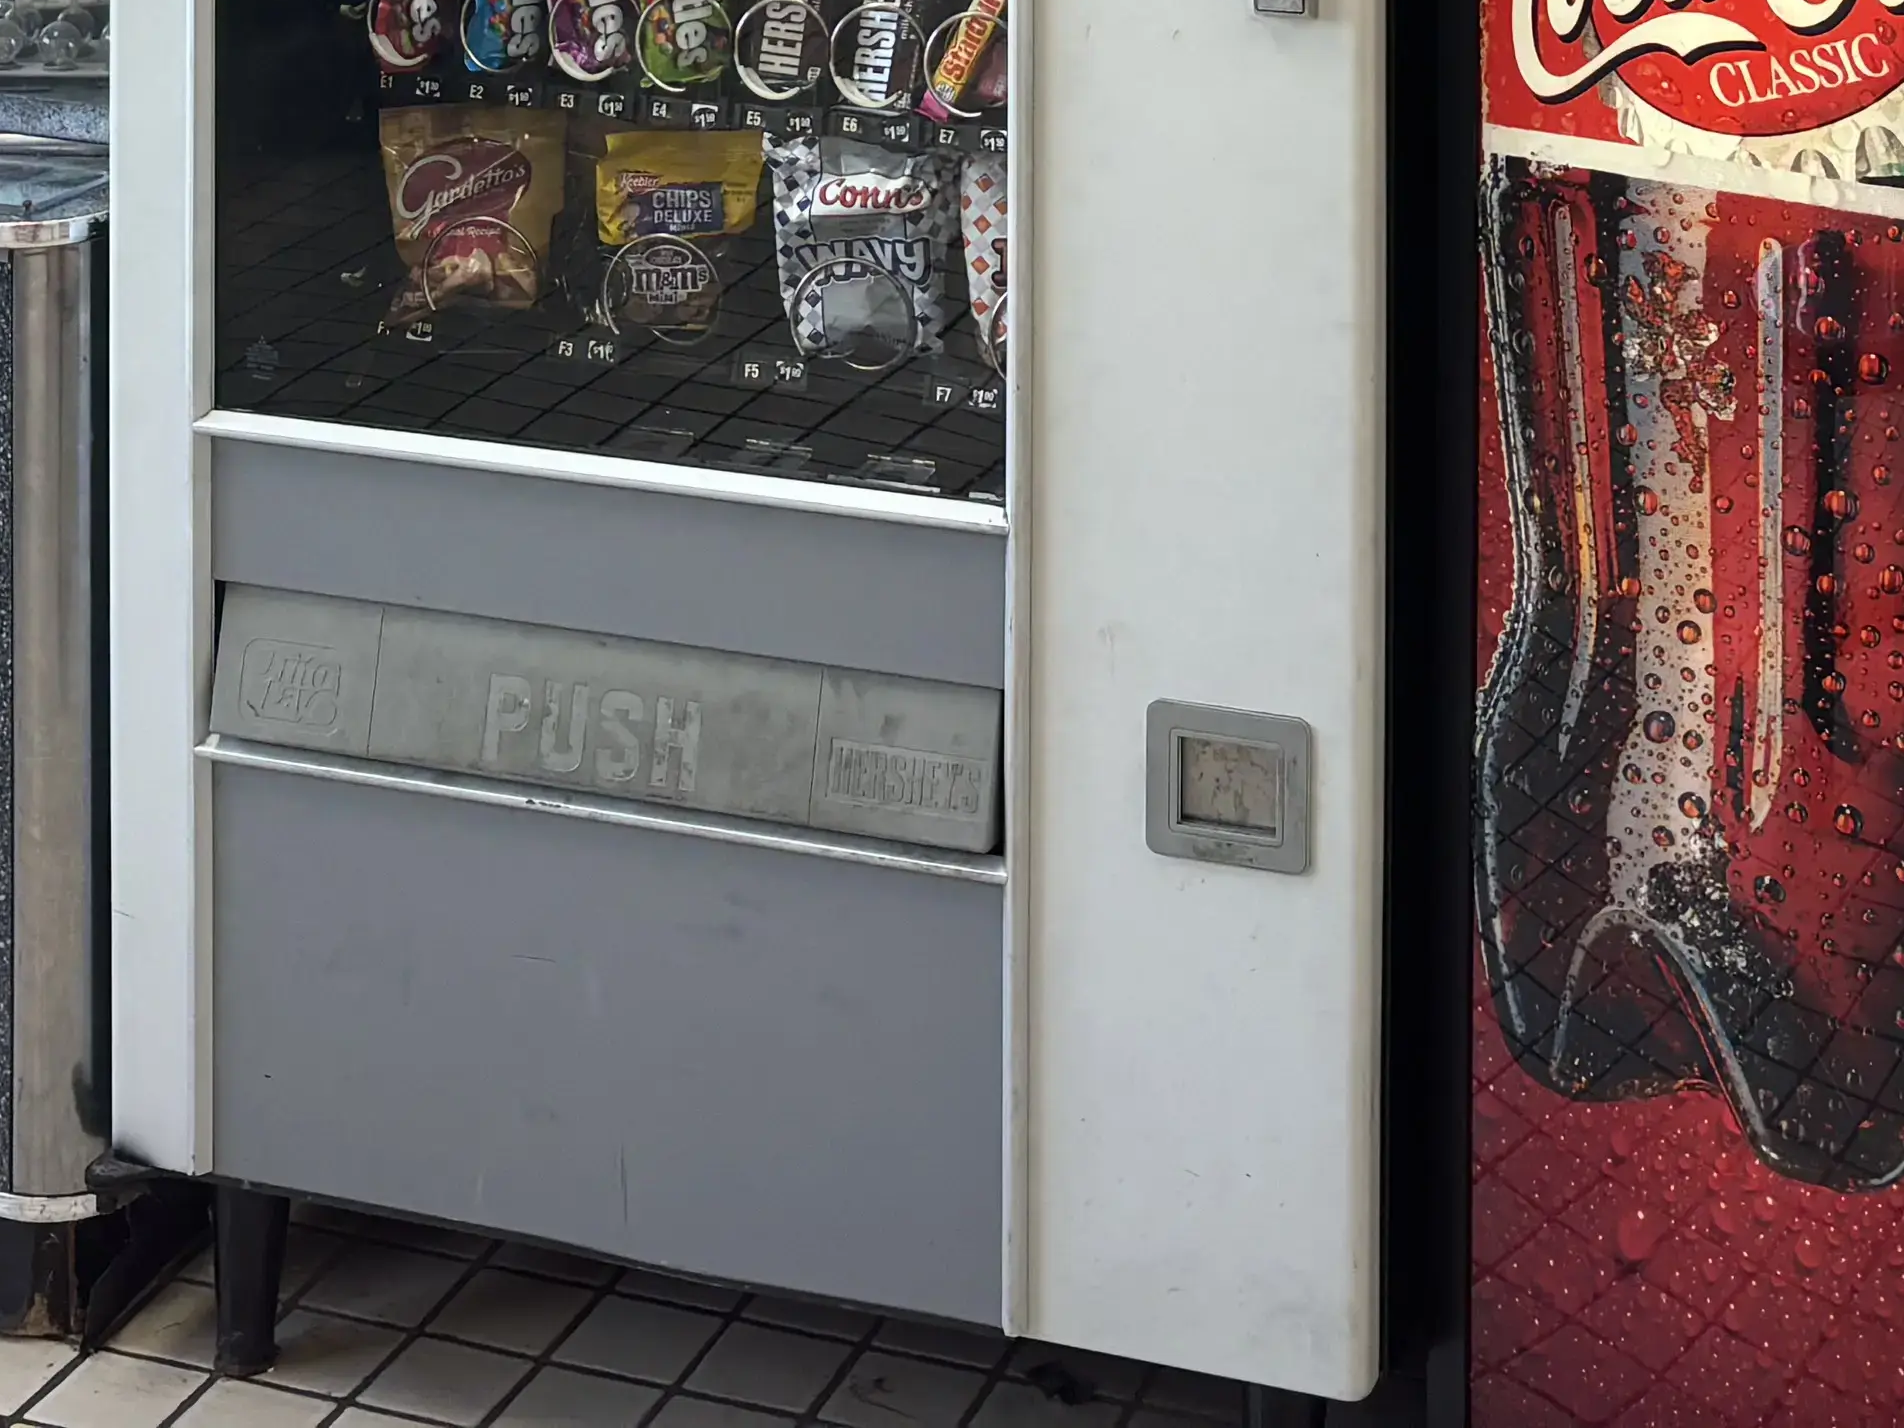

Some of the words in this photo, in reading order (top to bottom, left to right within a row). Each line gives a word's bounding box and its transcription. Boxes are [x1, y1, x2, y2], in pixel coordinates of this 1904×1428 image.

[1709, 32, 1890, 109] CLASSIC
[470, 85, 484, 99] E2
[560, 94, 574, 107] E3
[653, 103, 667, 117] E4
[746, 111, 762, 126] E5
[843, 117, 858, 132] E6
[940, 129, 955, 144] E7
[652, 189, 712, 209] CHIPS
[654, 209, 713, 223] DELUXE
[744, 364, 759, 378] F5
[936, 388, 951, 402] F7
[481, 672, 701, 791] PUSH
